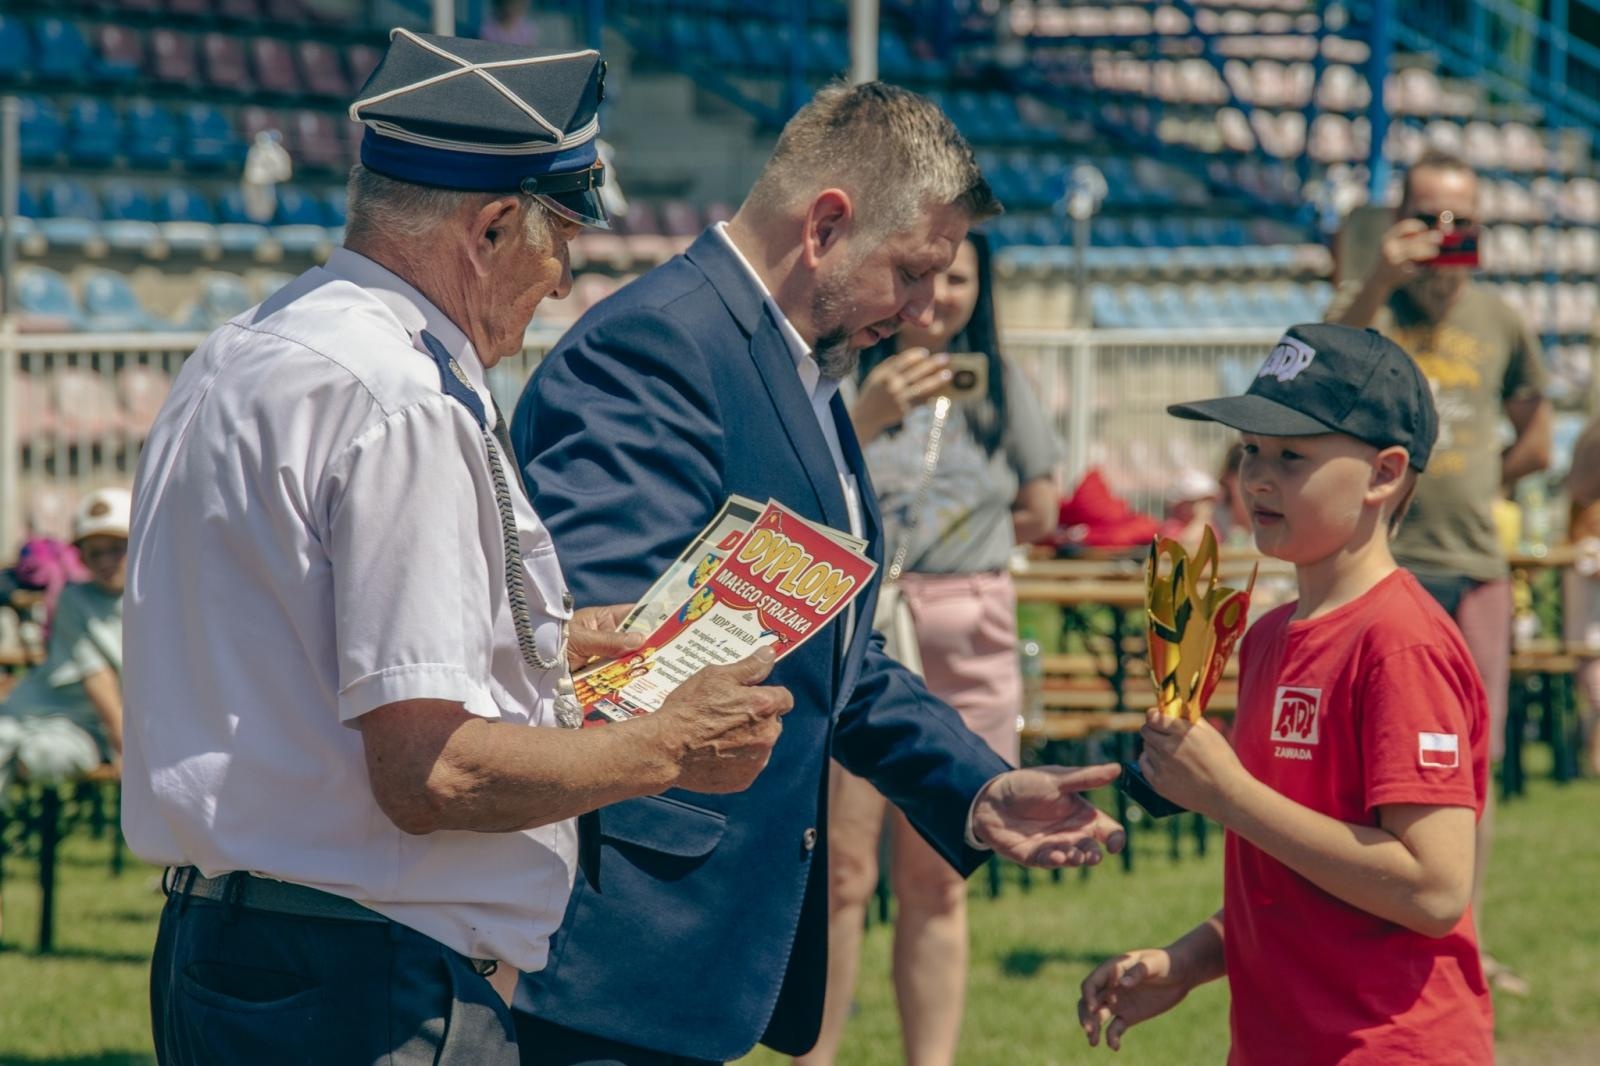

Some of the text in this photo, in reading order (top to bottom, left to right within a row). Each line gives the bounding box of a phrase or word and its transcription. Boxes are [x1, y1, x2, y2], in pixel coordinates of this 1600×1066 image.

[736, 528, 855, 615] DYPLOM
[715, 568, 812, 635] MAŁEGO STRAŻAKA
[710, 614, 732, 628] MDP
[725, 623, 758, 646] ZAWADA
[1274, 746, 1312, 760] ZAWADA
